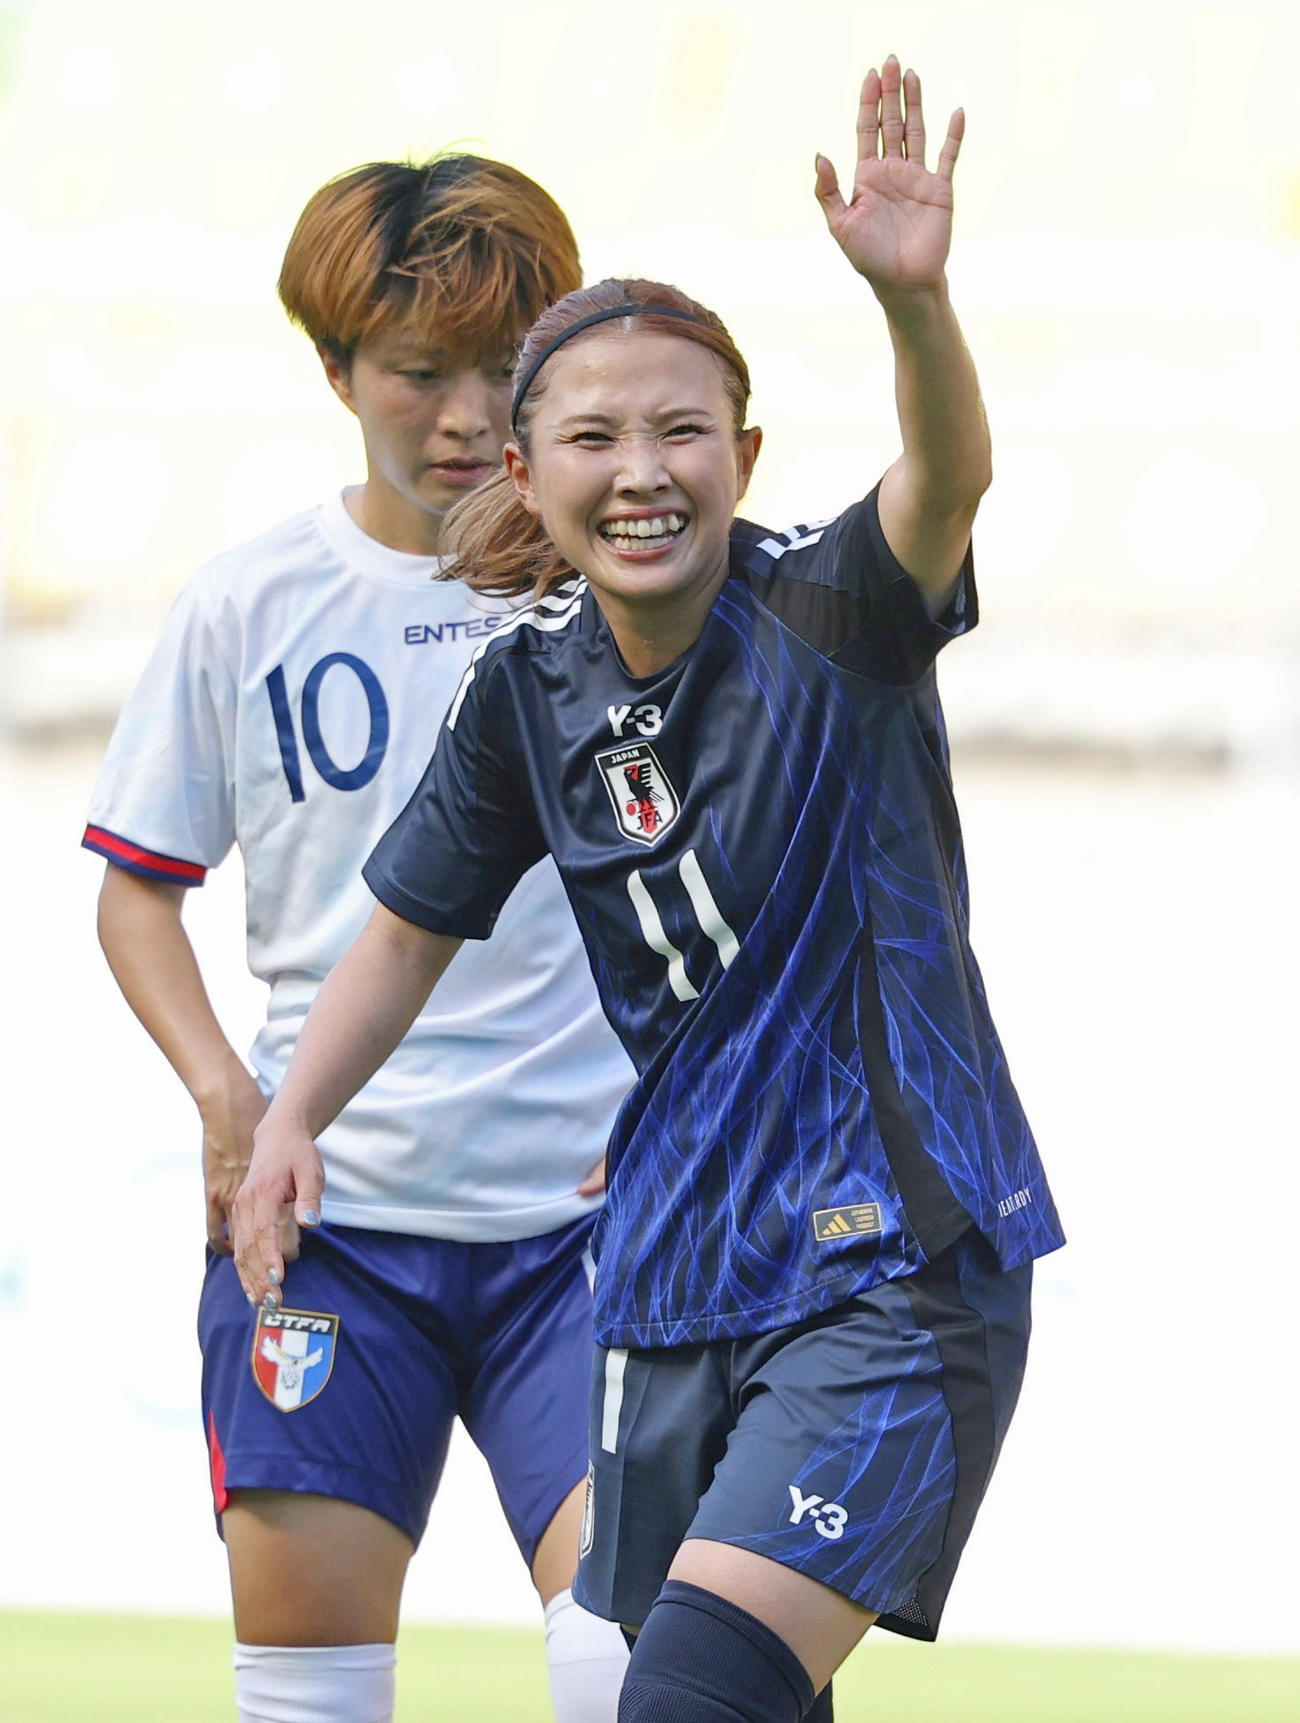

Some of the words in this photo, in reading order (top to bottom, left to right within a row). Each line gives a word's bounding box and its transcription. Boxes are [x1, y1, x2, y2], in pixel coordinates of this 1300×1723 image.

[265, 652, 390, 803] 10
[607, 704, 663, 737] Y-3
[611, 749, 640, 764] JAPAN
[637, 810, 663, 830] JFA
[627, 849, 741, 1002] 11
[788, 1485, 848, 1539] Y-3
